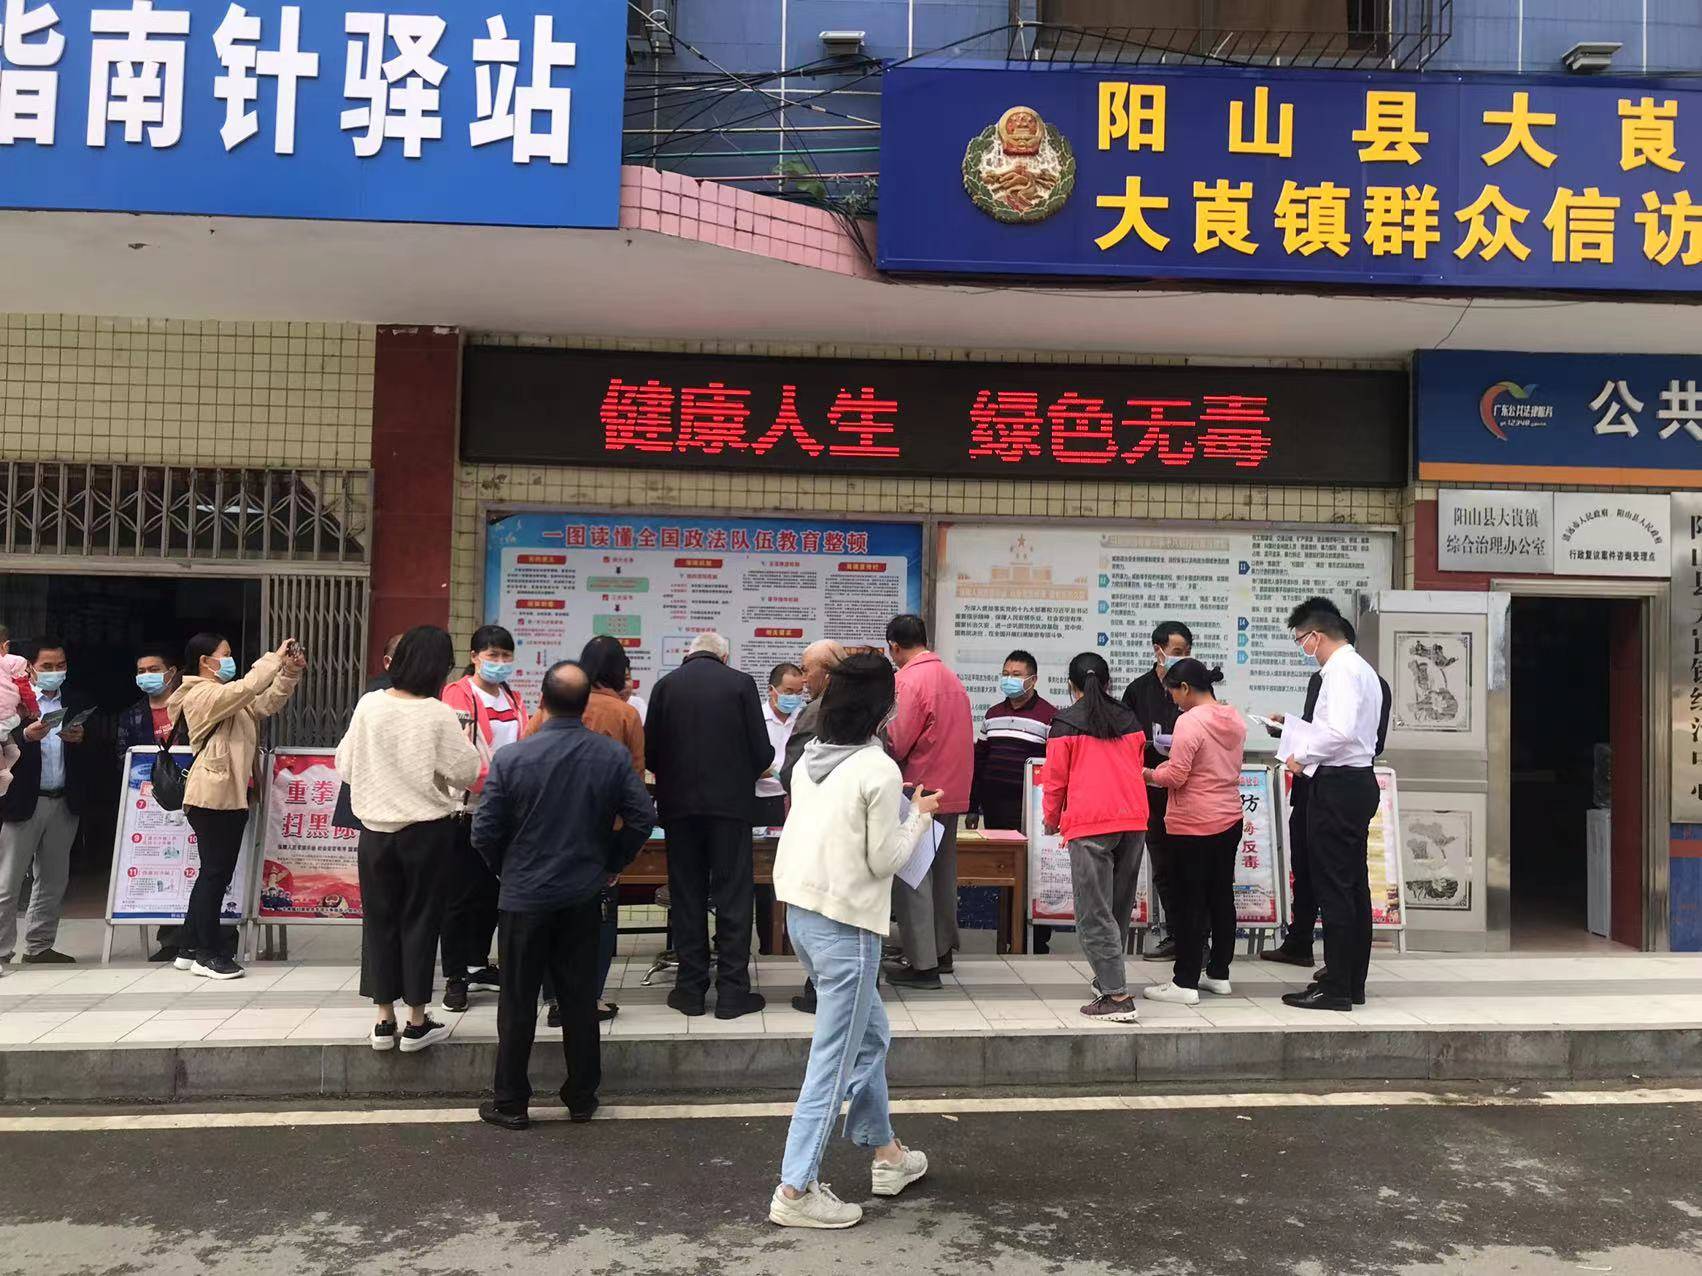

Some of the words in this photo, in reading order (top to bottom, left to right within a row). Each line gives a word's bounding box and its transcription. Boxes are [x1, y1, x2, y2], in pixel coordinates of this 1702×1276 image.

[1095, 176, 1702, 266] 大崀镇群众信访
[600, 378, 899, 457] 健康人生
[969, 389, 1271, 467] 绿色无毒
[1588, 379, 1702, 441] 公共
[1454, 507, 1538, 527] 阳山县大崀镇
[1617, 508, 1663, 544] 阳山县人民政府
[541, 524, 867, 553] 一图读懂全国政法队伍教育整顿
[1446, 534, 1545, 556] 综合治理办公室
[1569, 549, 1656, 561] 行政复议案件咨询受理点
[285, 780, 334, 805] 重拳
